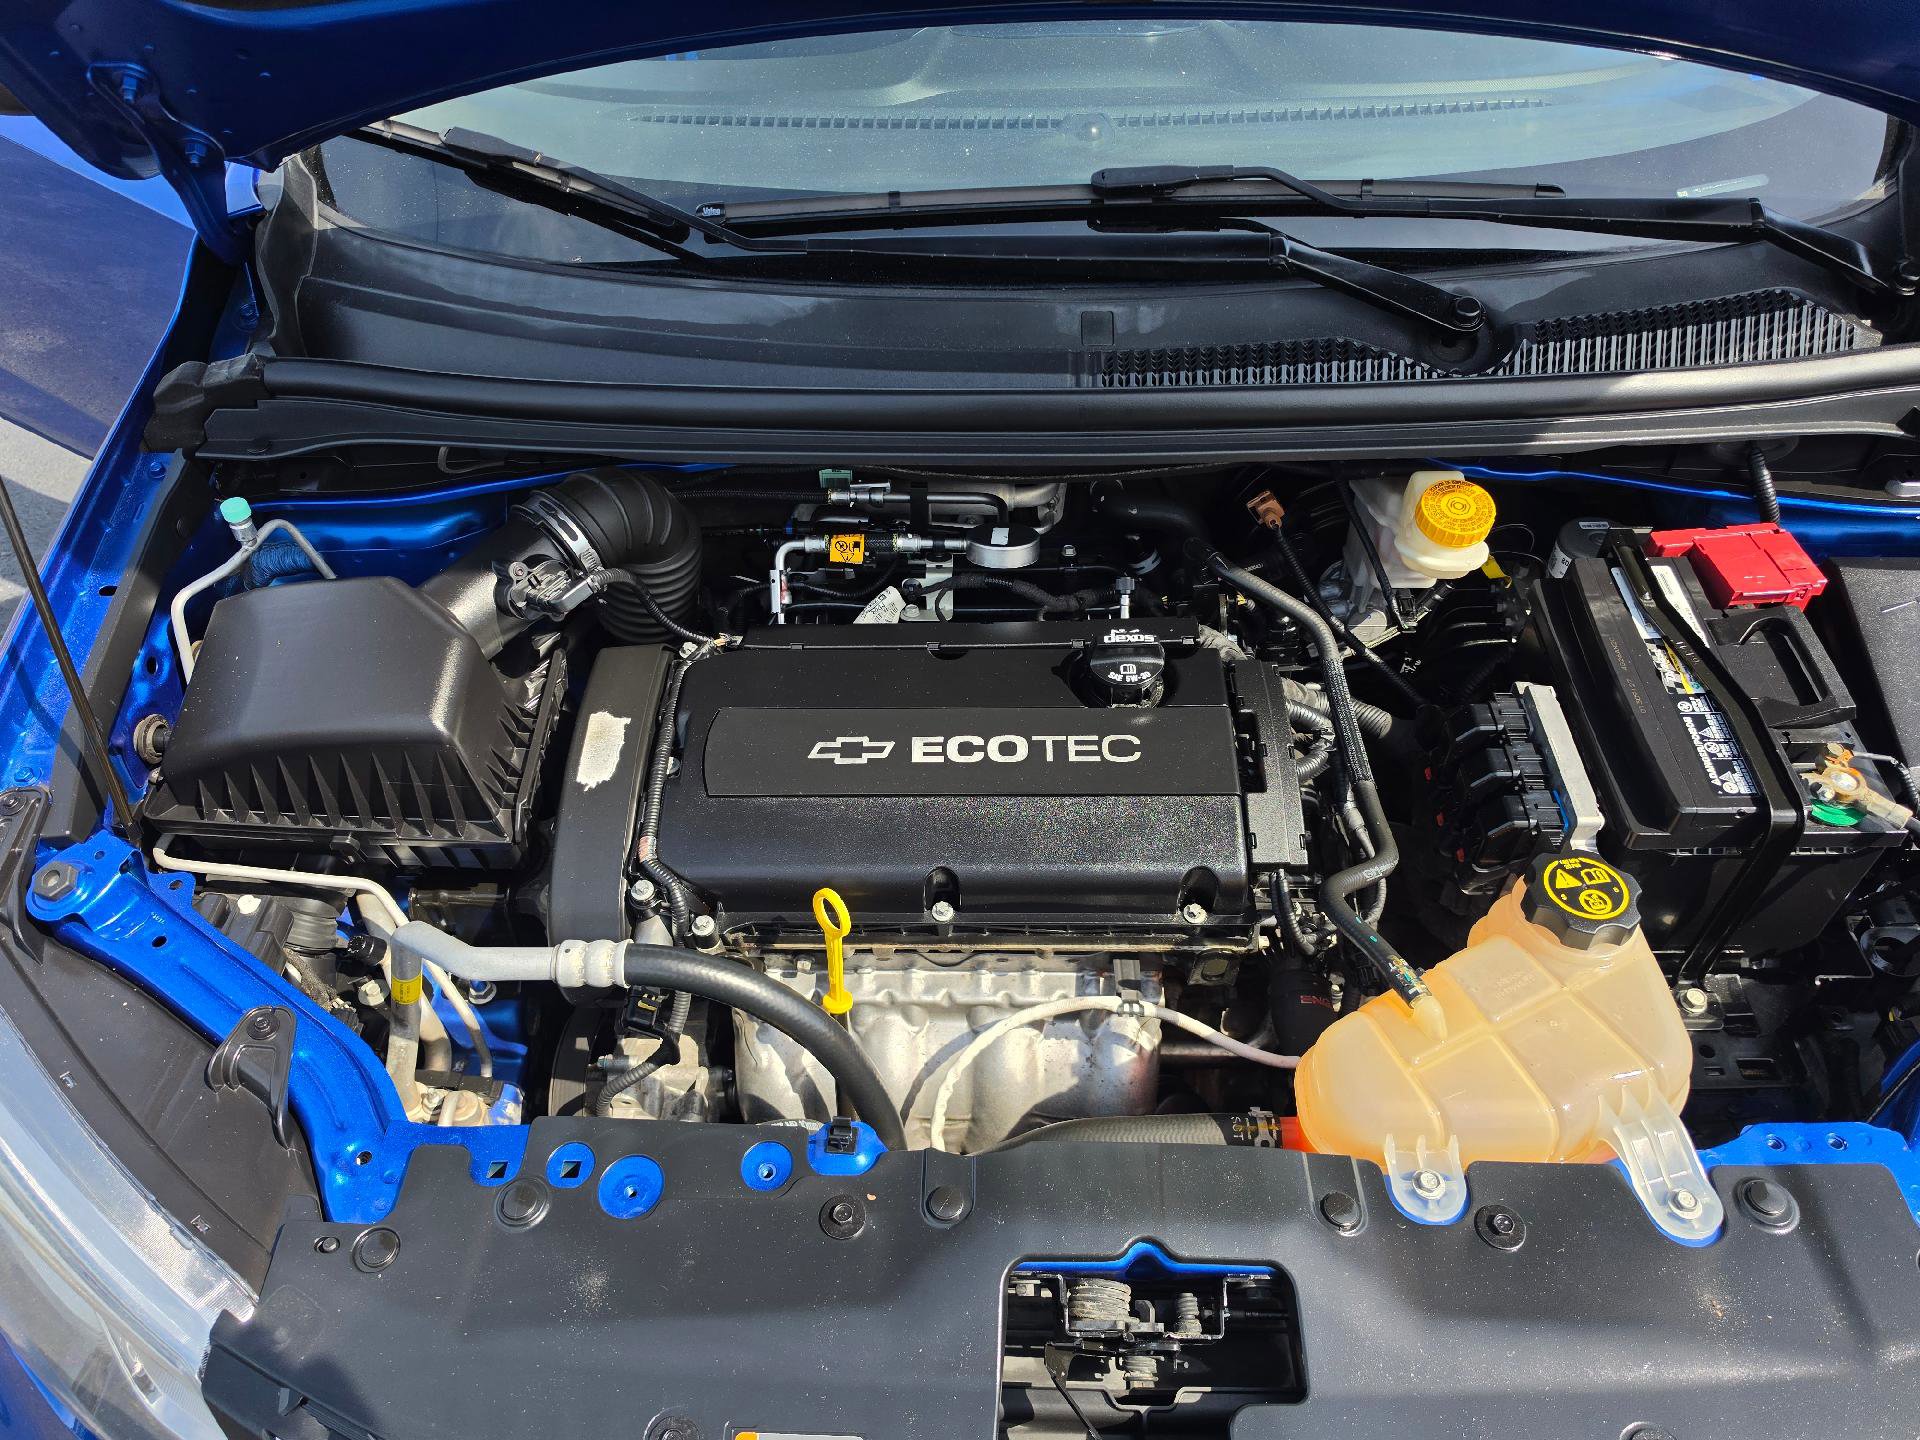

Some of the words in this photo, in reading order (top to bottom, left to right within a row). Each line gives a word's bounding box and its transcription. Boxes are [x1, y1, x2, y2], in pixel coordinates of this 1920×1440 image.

[1103, 629, 1155, 643] dexos
[1107, 671, 1123, 682] SAE
[1125, 671, 1152, 683] 5W-30
[910, 734, 1142, 763] ECOTEC
